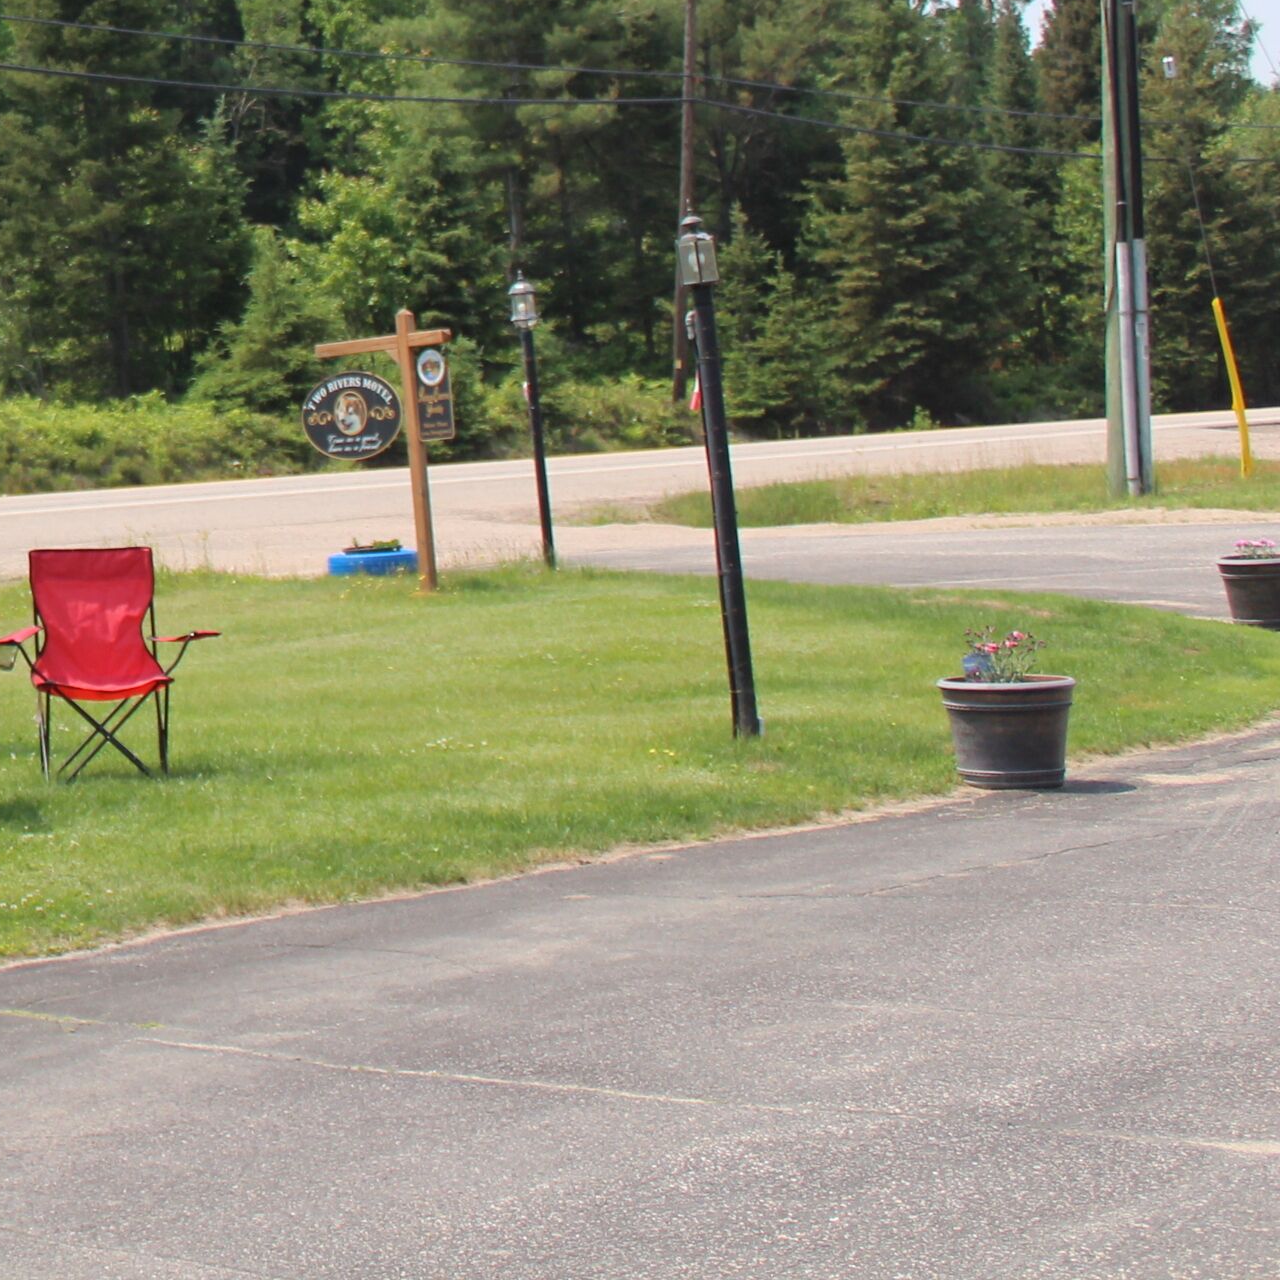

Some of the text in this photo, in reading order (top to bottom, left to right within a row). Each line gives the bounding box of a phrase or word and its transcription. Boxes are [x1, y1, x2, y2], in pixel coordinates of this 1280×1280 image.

[307, 387, 327, 411] TWO
[327, 377, 361, 393] RIVERS
[362, 378, 393, 405] MOTEL
